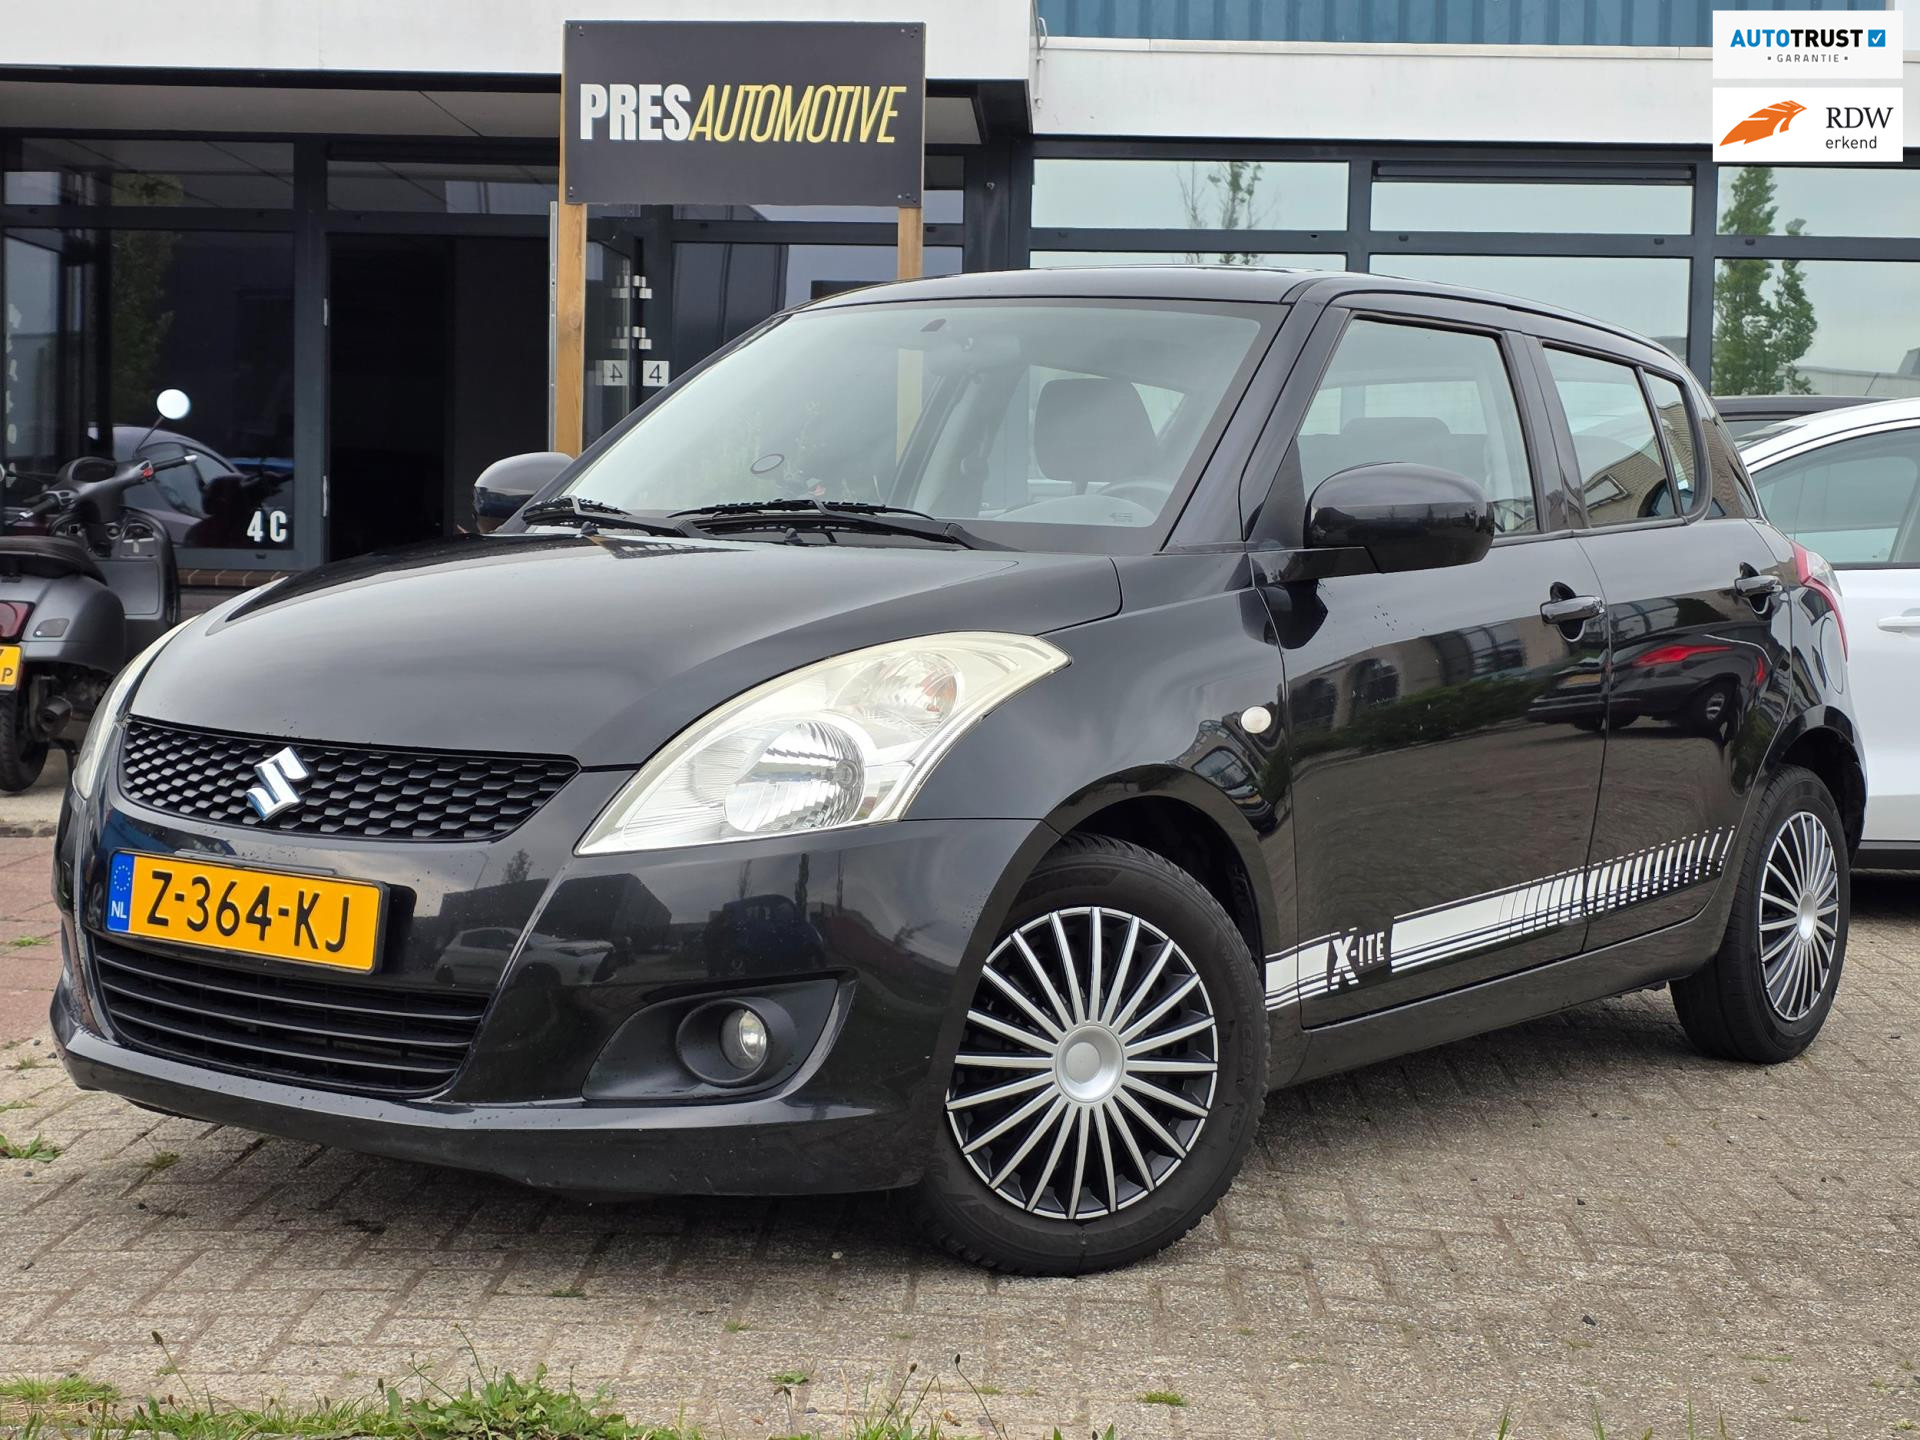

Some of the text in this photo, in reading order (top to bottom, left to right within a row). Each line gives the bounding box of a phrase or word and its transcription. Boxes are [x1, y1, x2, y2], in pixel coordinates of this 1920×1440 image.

[579, 83, 907, 144] PRESAUTOMOTIVE
[649, 363, 662, 384] 4
[110, 900, 127, 919] NL
[147, 870, 350, 953] Z-364-KJ
